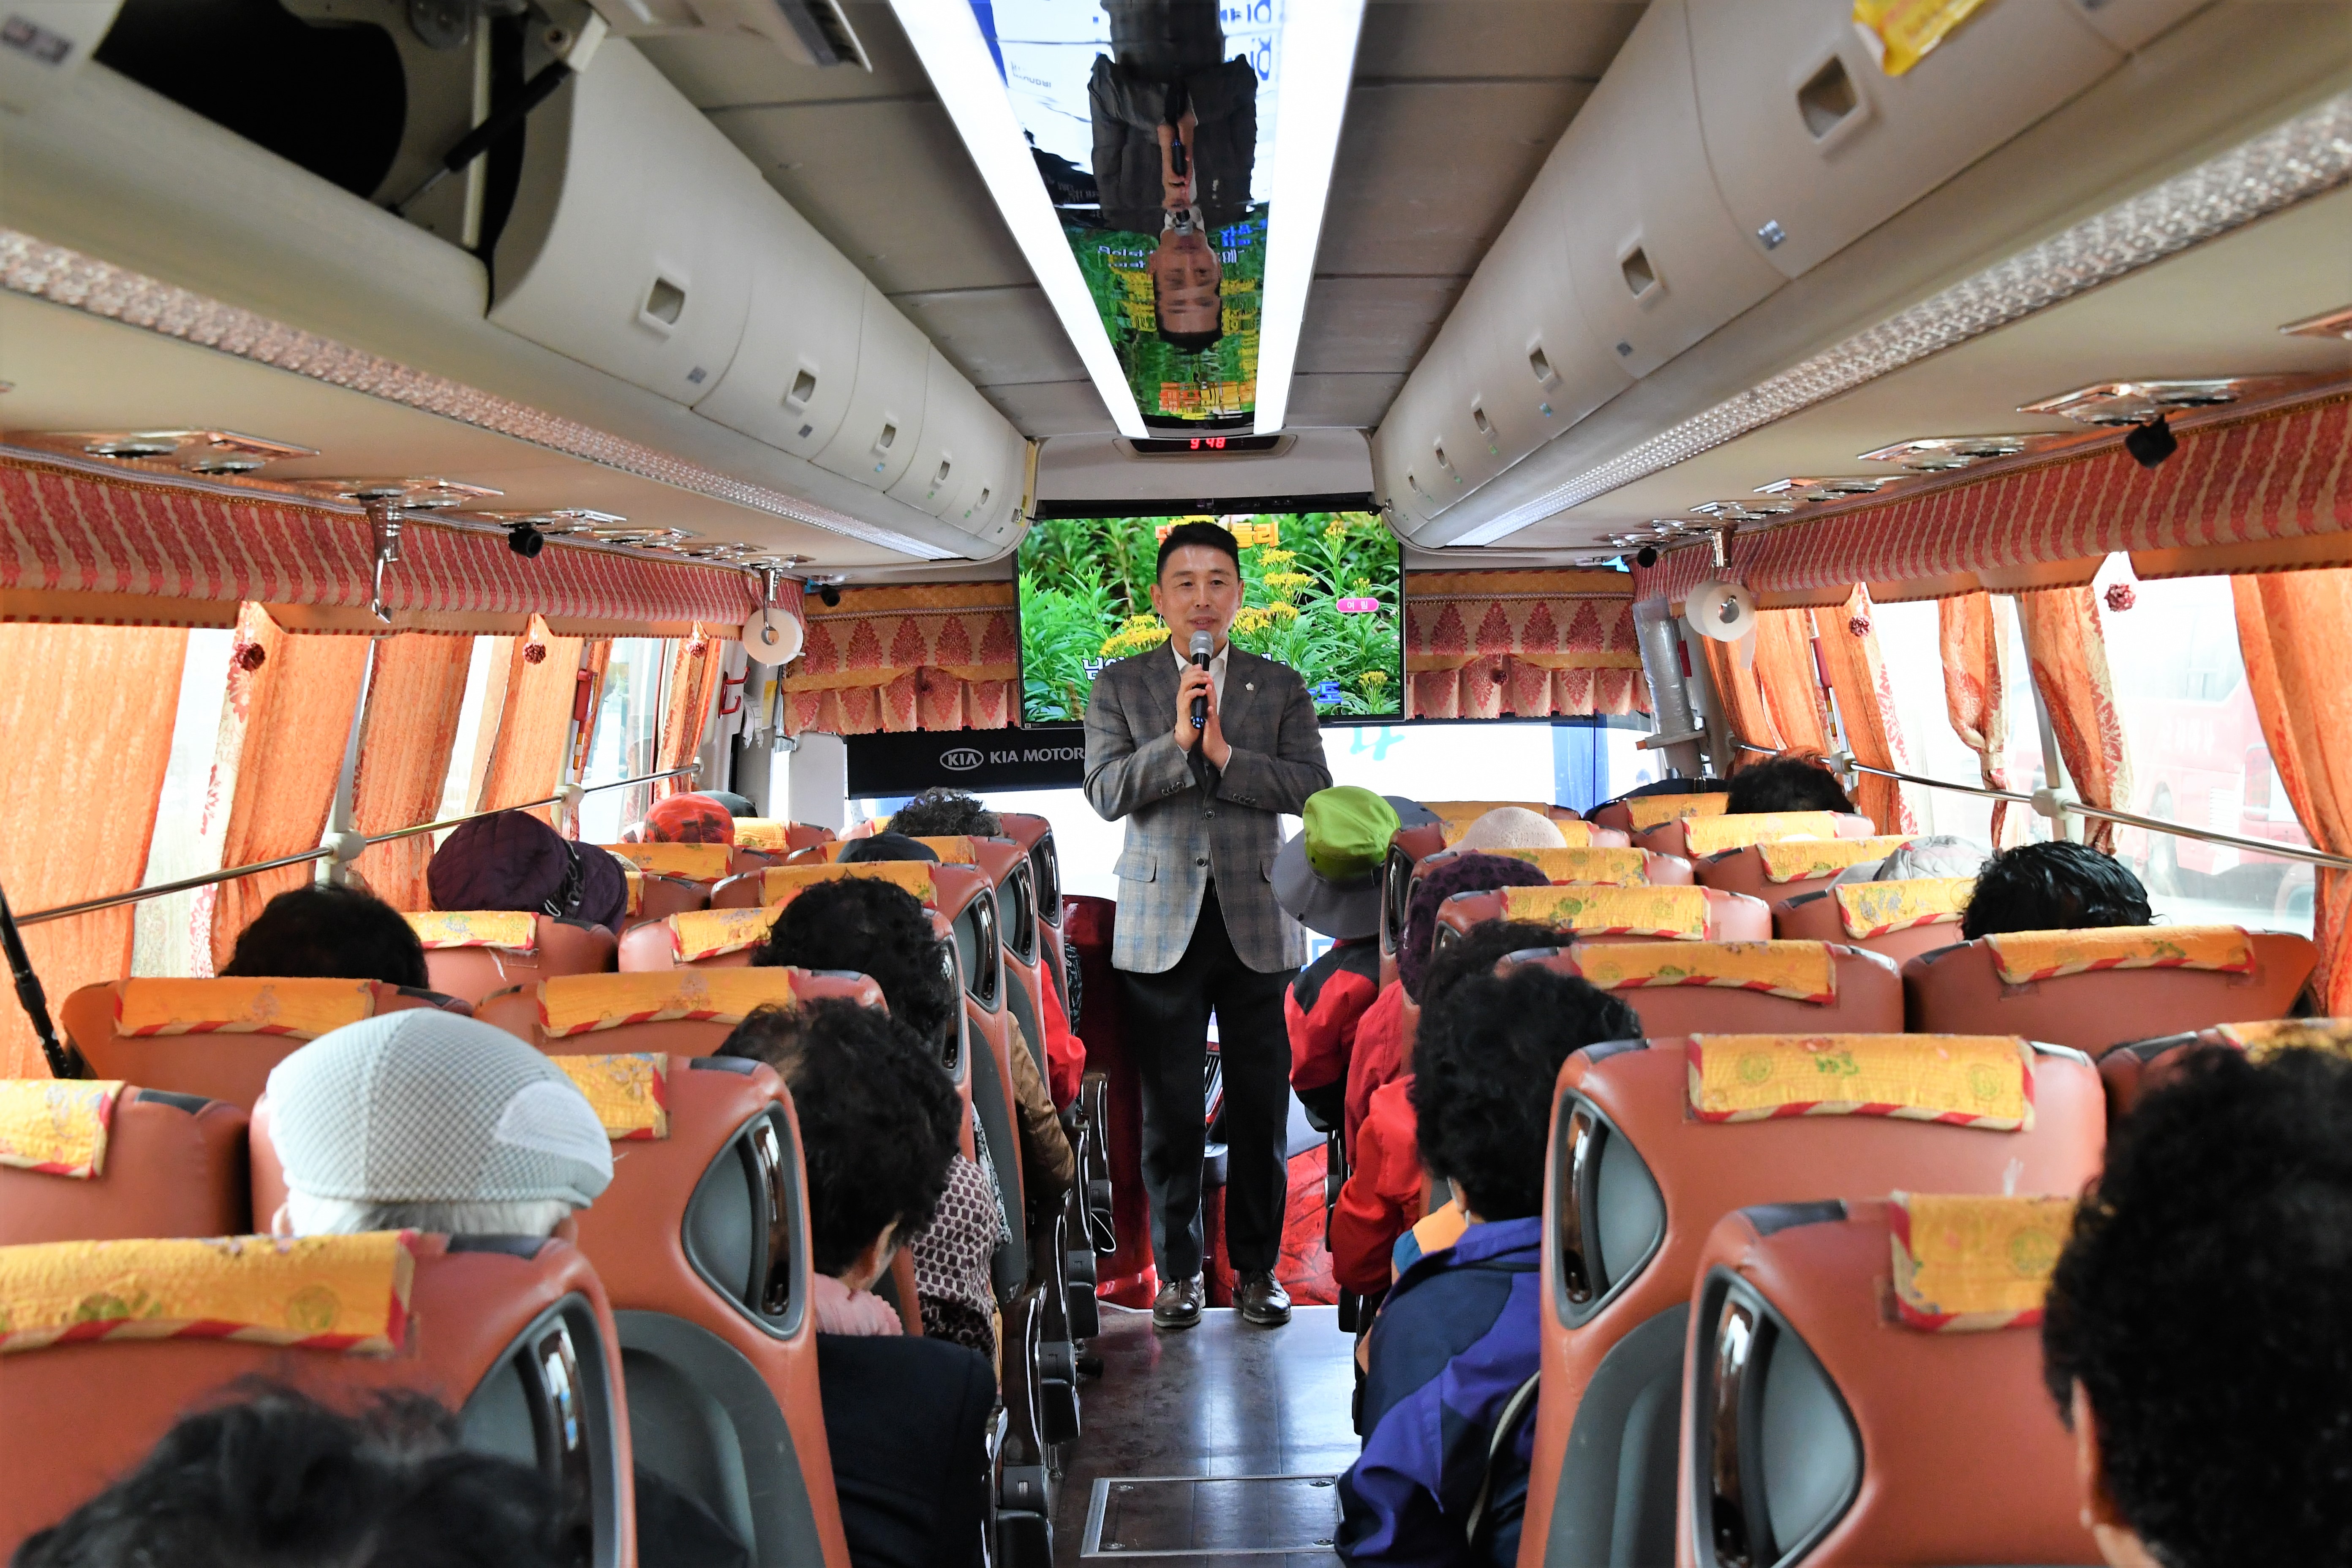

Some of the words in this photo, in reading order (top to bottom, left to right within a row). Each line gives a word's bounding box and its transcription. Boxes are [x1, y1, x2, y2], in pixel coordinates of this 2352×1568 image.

[947, 753, 977, 766] KIA
[990, 750, 1018, 764] KIA
[1023, 747, 1086, 762] MOTOR
